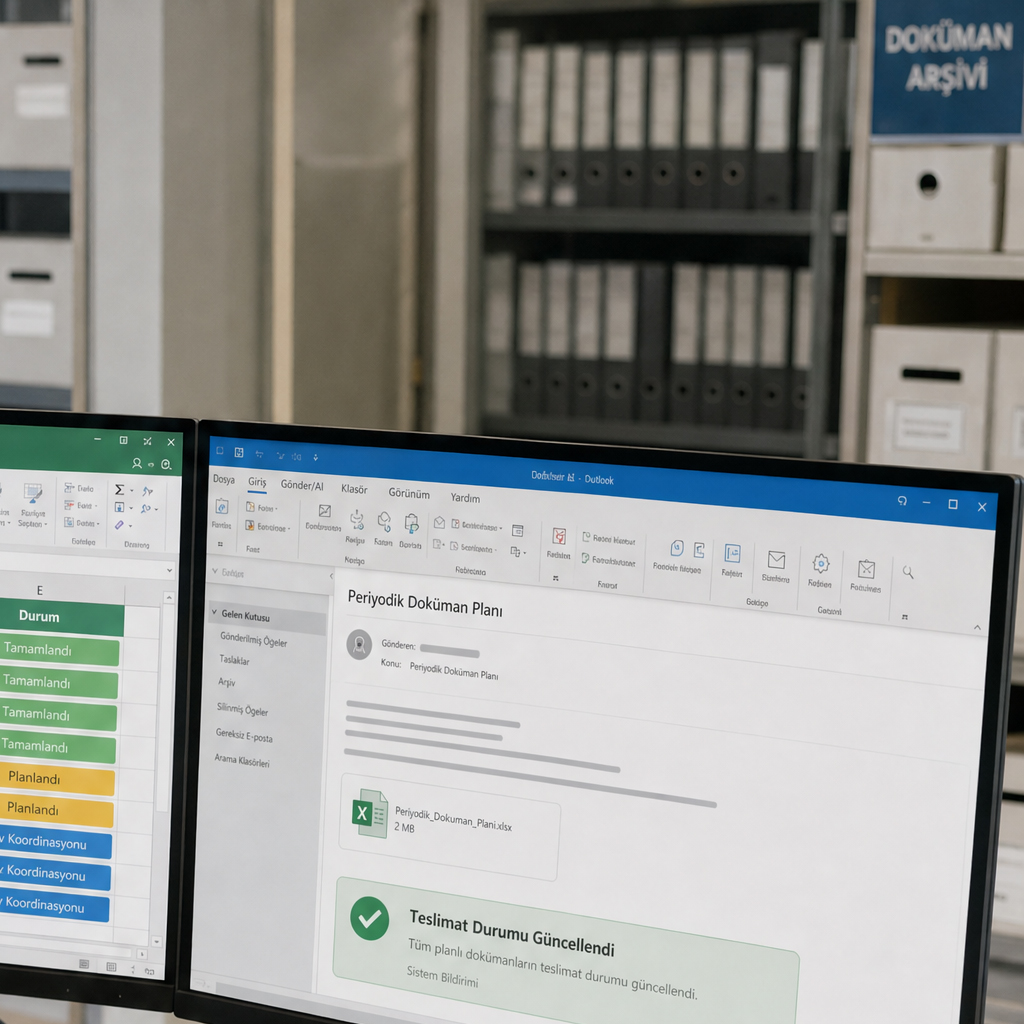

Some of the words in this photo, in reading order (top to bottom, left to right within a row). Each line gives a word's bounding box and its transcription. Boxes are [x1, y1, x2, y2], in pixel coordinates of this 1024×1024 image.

[885, 18, 1014, 54] DOKÜMAN
[906, 57, 988, 97] ARŞİVİ
[213, 473, 235, 486] Dosya
[248, 476, 267, 489] Giriş
[341, 483, 368, 494] Klasör
[388, 487, 430, 499] Görünüm
[450, 492, 481, 503] Yardım
[37, 585, 43, 596] E
[348, 589, 404, 609] Periyodik
[408, 595, 468, 614] Doküman
[472, 601, 503, 617] Planı
[19, 609, 60, 623] Durum
[221, 609, 243, 619] Gelen
[244, 612, 270, 623] Kutusu
[3, 641, 72, 656] Tamamlandı
[381, 658, 402, 668] Konu:
[410, 661, 442, 674] Periyodik
[443, 666, 479, 678] Doküman
[480, 670, 499, 681] Planı
[3, 673, 70, 689] Tamamlandı
[2, 705, 70, 721] Tamamlandı
[215, 727, 245, 740] Gereksiz
[246, 731, 273, 743] E-posta
[1, 737, 68, 754] Tamamlandı
[214, 753, 237, 764] Arama
[8, 770, 60, 785] Planlandı
[7, 801, 59, 816] Planlandı
[394, 821, 400, 831] 2
[401, 823, 415, 834] MB
[8, 833, 87, 851] Koordinasyonu
[7, 864, 86, 883] Koordinasyonu
[6, 896, 85, 914] Koordinasyonu
[409, 909, 468, 932] Teslimat
[473, 920, 529, 942] Durumu
[533, 931, 615, 957] Güncellendi
[407, 965, 438, 981] Sistem
[441, 972, 479, 988] Bildirimi
[408, 937, 432, 952] Tüm
[434, 943, 464, 959] planlı
[465, 948, 537, 971] dokümanların
[540, 962, 582, 980] teslimat
[585, 969, 628, 987] durumu
[631, 979, 698, 1000] güncellendi.
